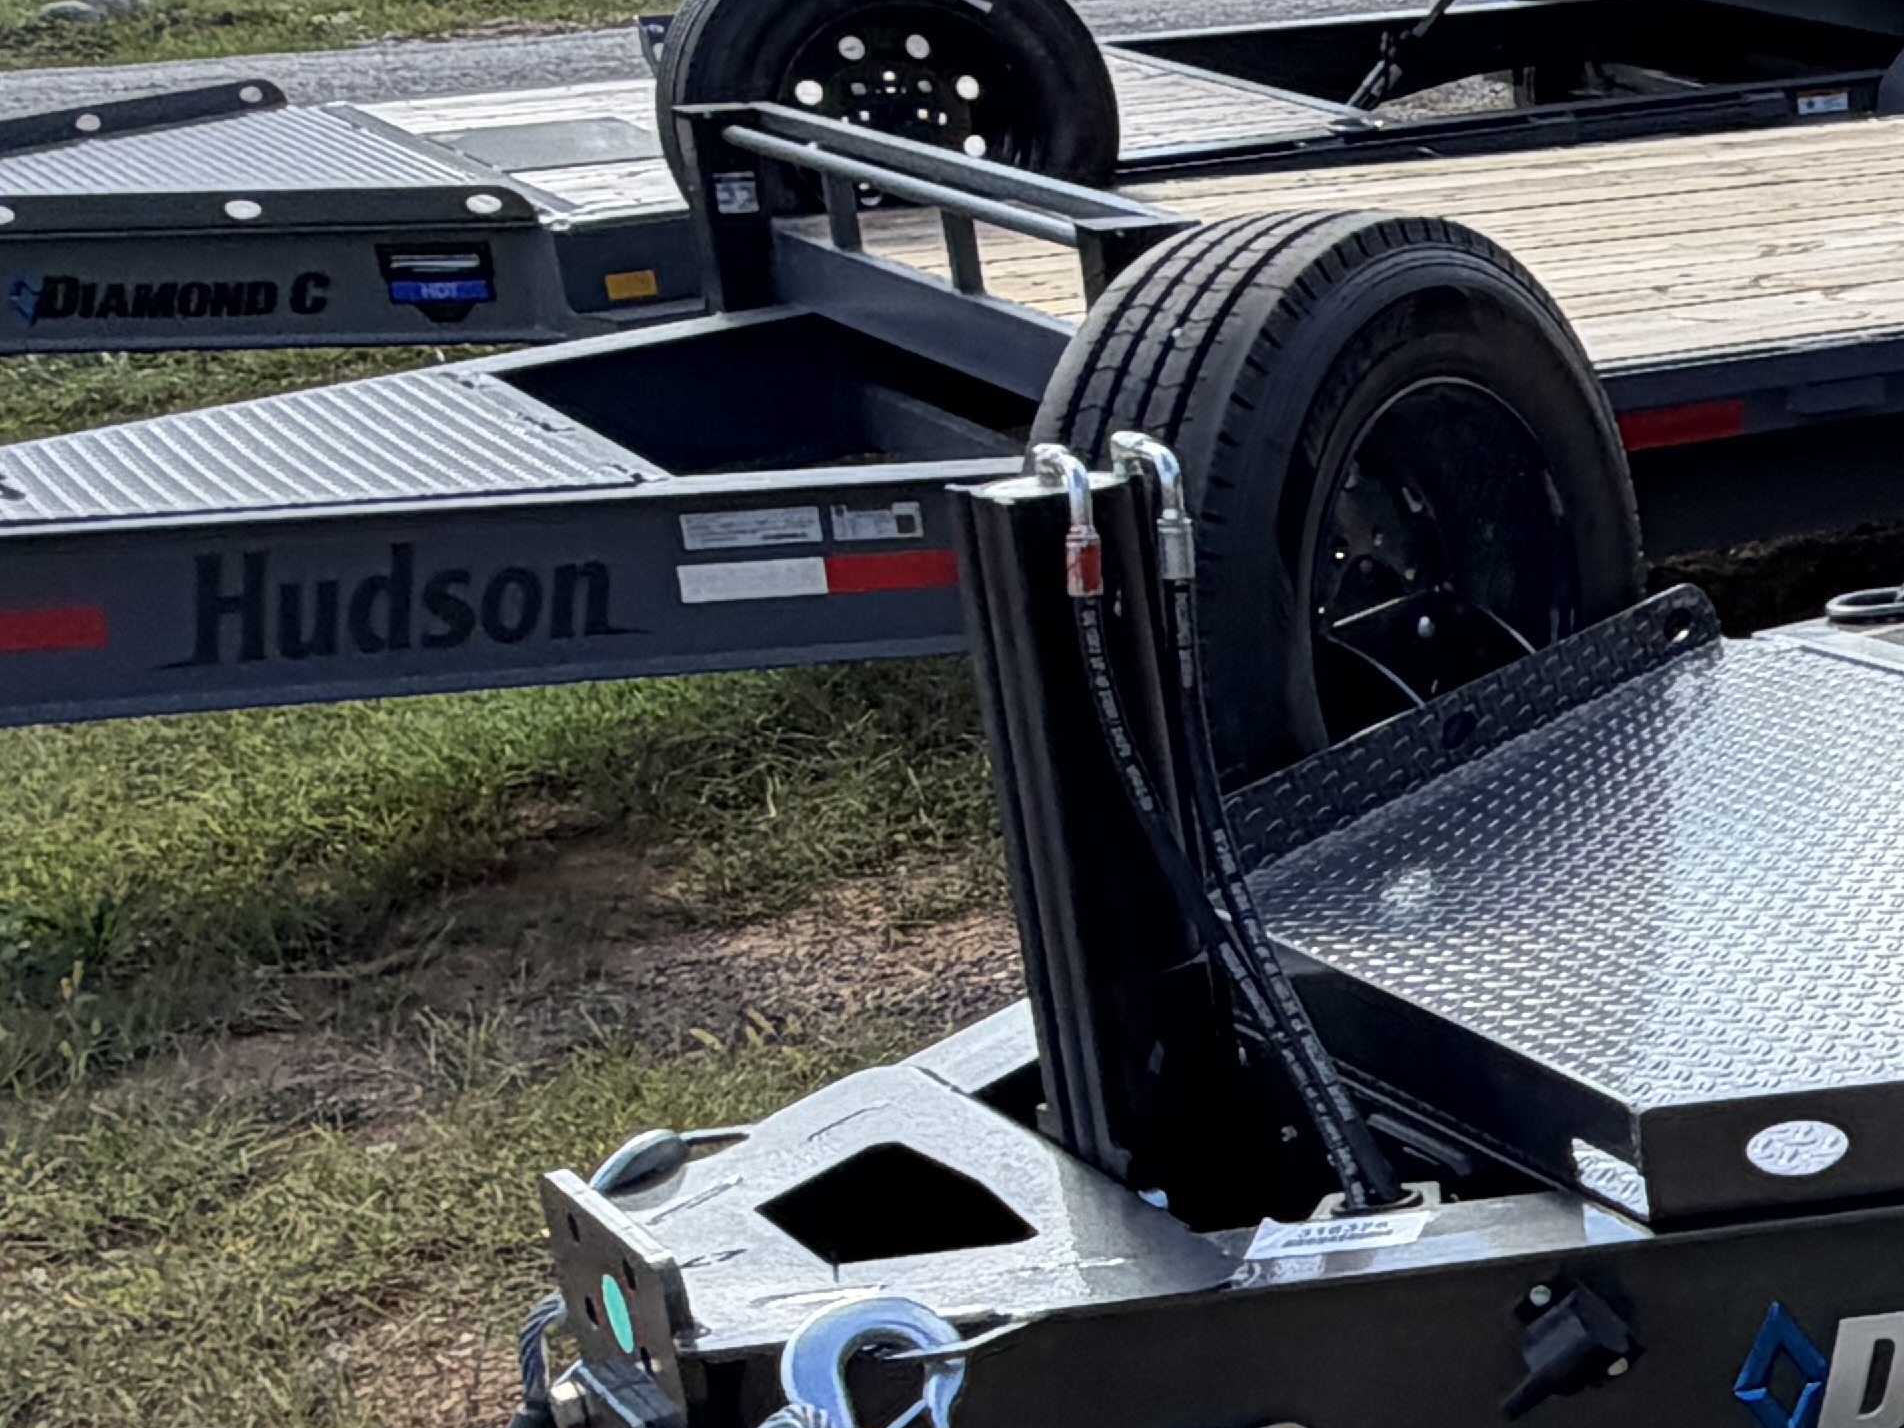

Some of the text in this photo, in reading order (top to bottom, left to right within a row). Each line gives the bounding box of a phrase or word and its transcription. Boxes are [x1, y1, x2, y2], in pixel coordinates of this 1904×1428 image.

[35, 272, 331, 319] DIAMOND C
[156, 542, 654, 669] Hudson
